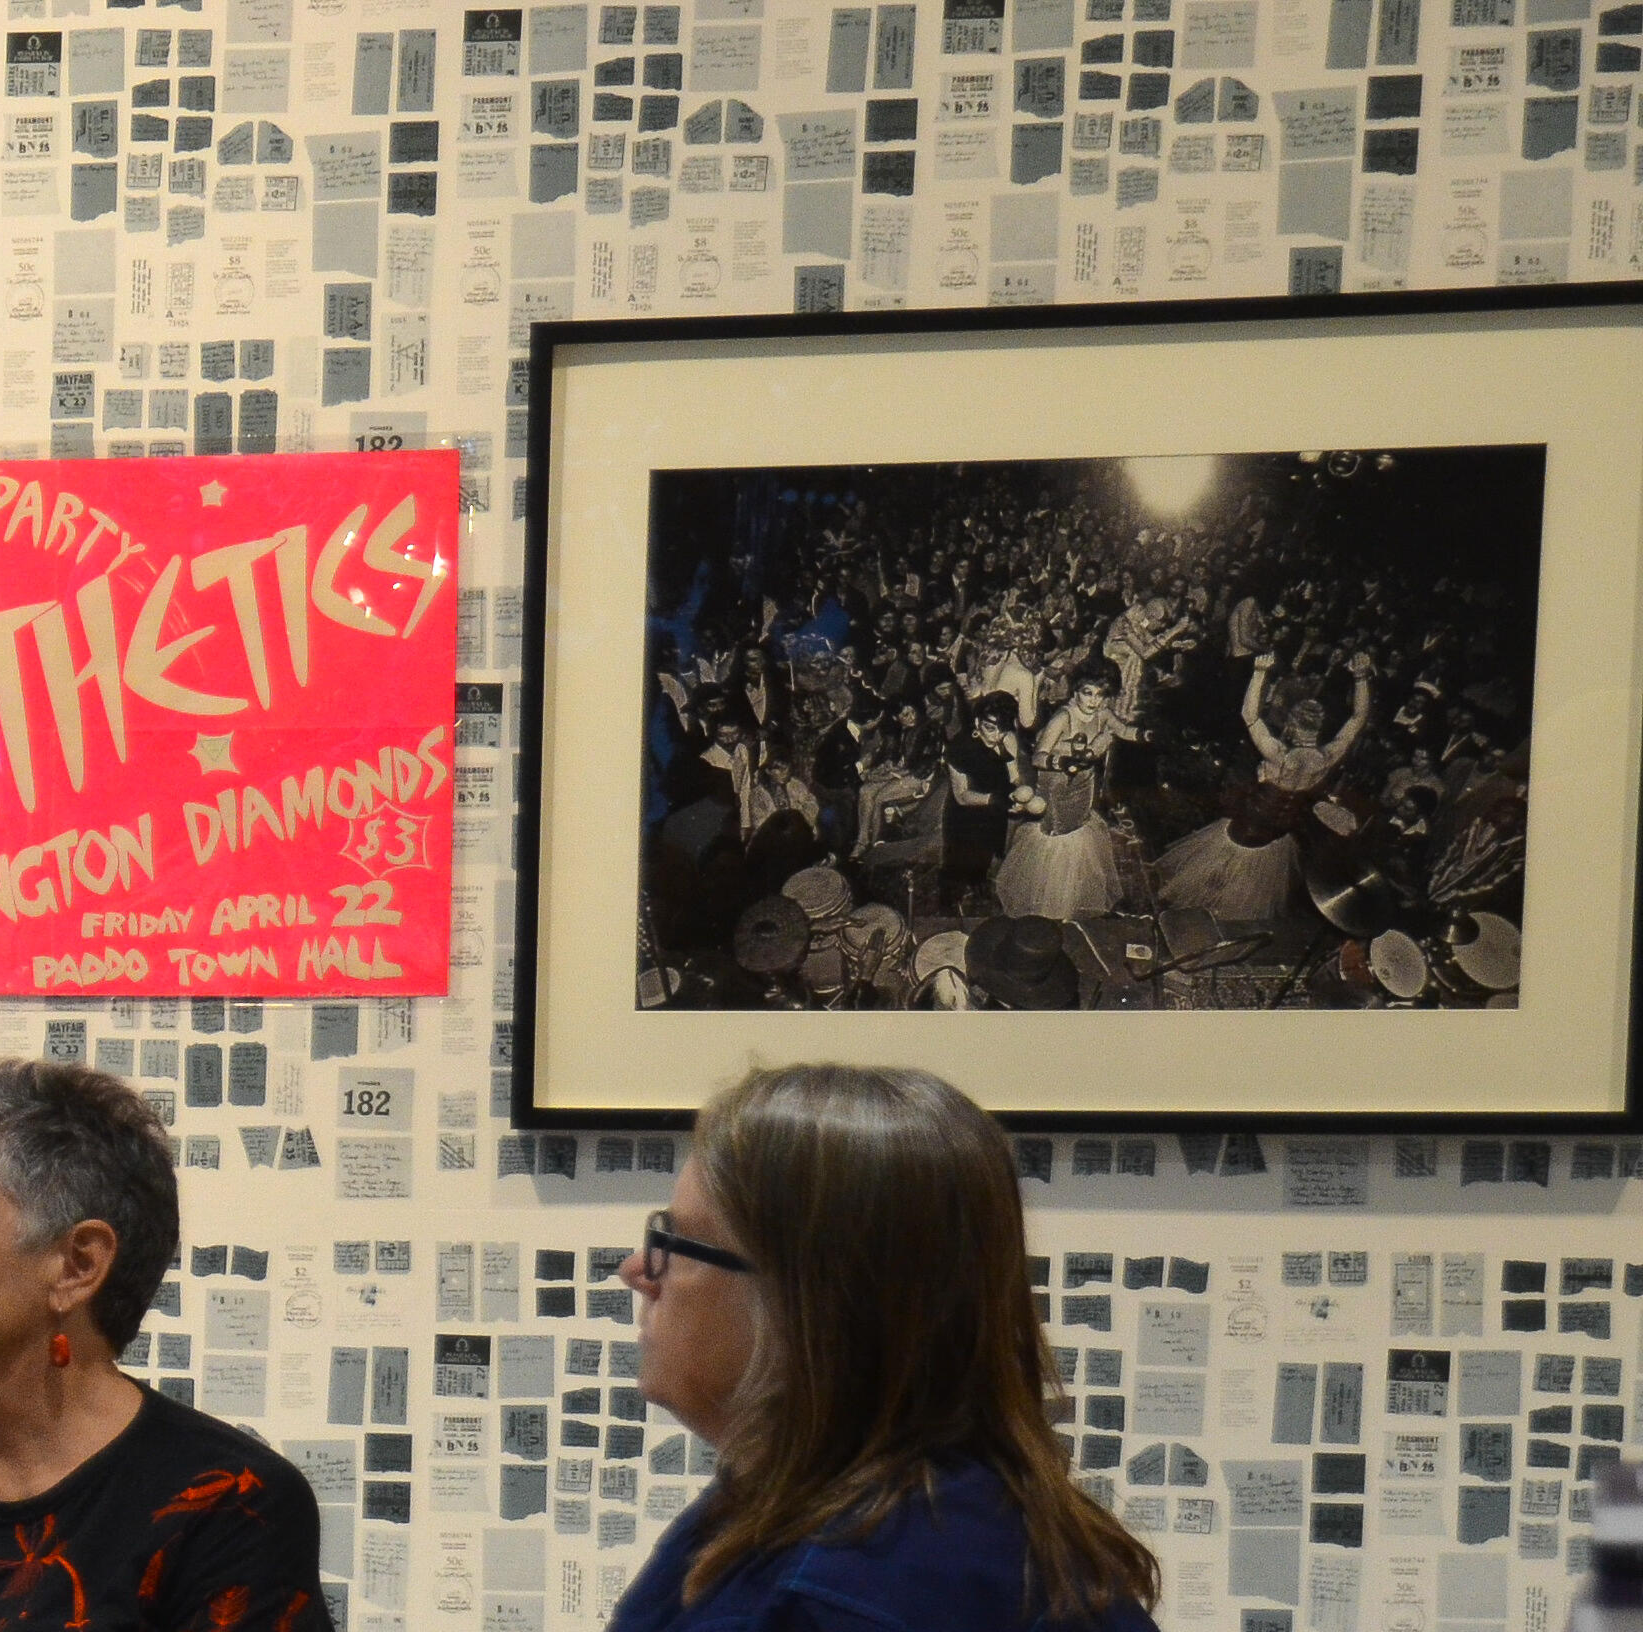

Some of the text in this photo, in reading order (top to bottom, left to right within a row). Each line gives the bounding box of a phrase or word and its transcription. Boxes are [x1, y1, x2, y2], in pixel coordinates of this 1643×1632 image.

[55, 374, 93, 386] MAYFAIR
[355, 436, 404, 453] 182
[183, 725, 446, 866] DIAMONDS
[356, 816, 416, 866] $3
[81, 880, 402, 938] FRIDAY APRIL 22
[33, 935, 403, 988] PADDO TOWN HALL
[343, 1090, 391, 1116] 182
